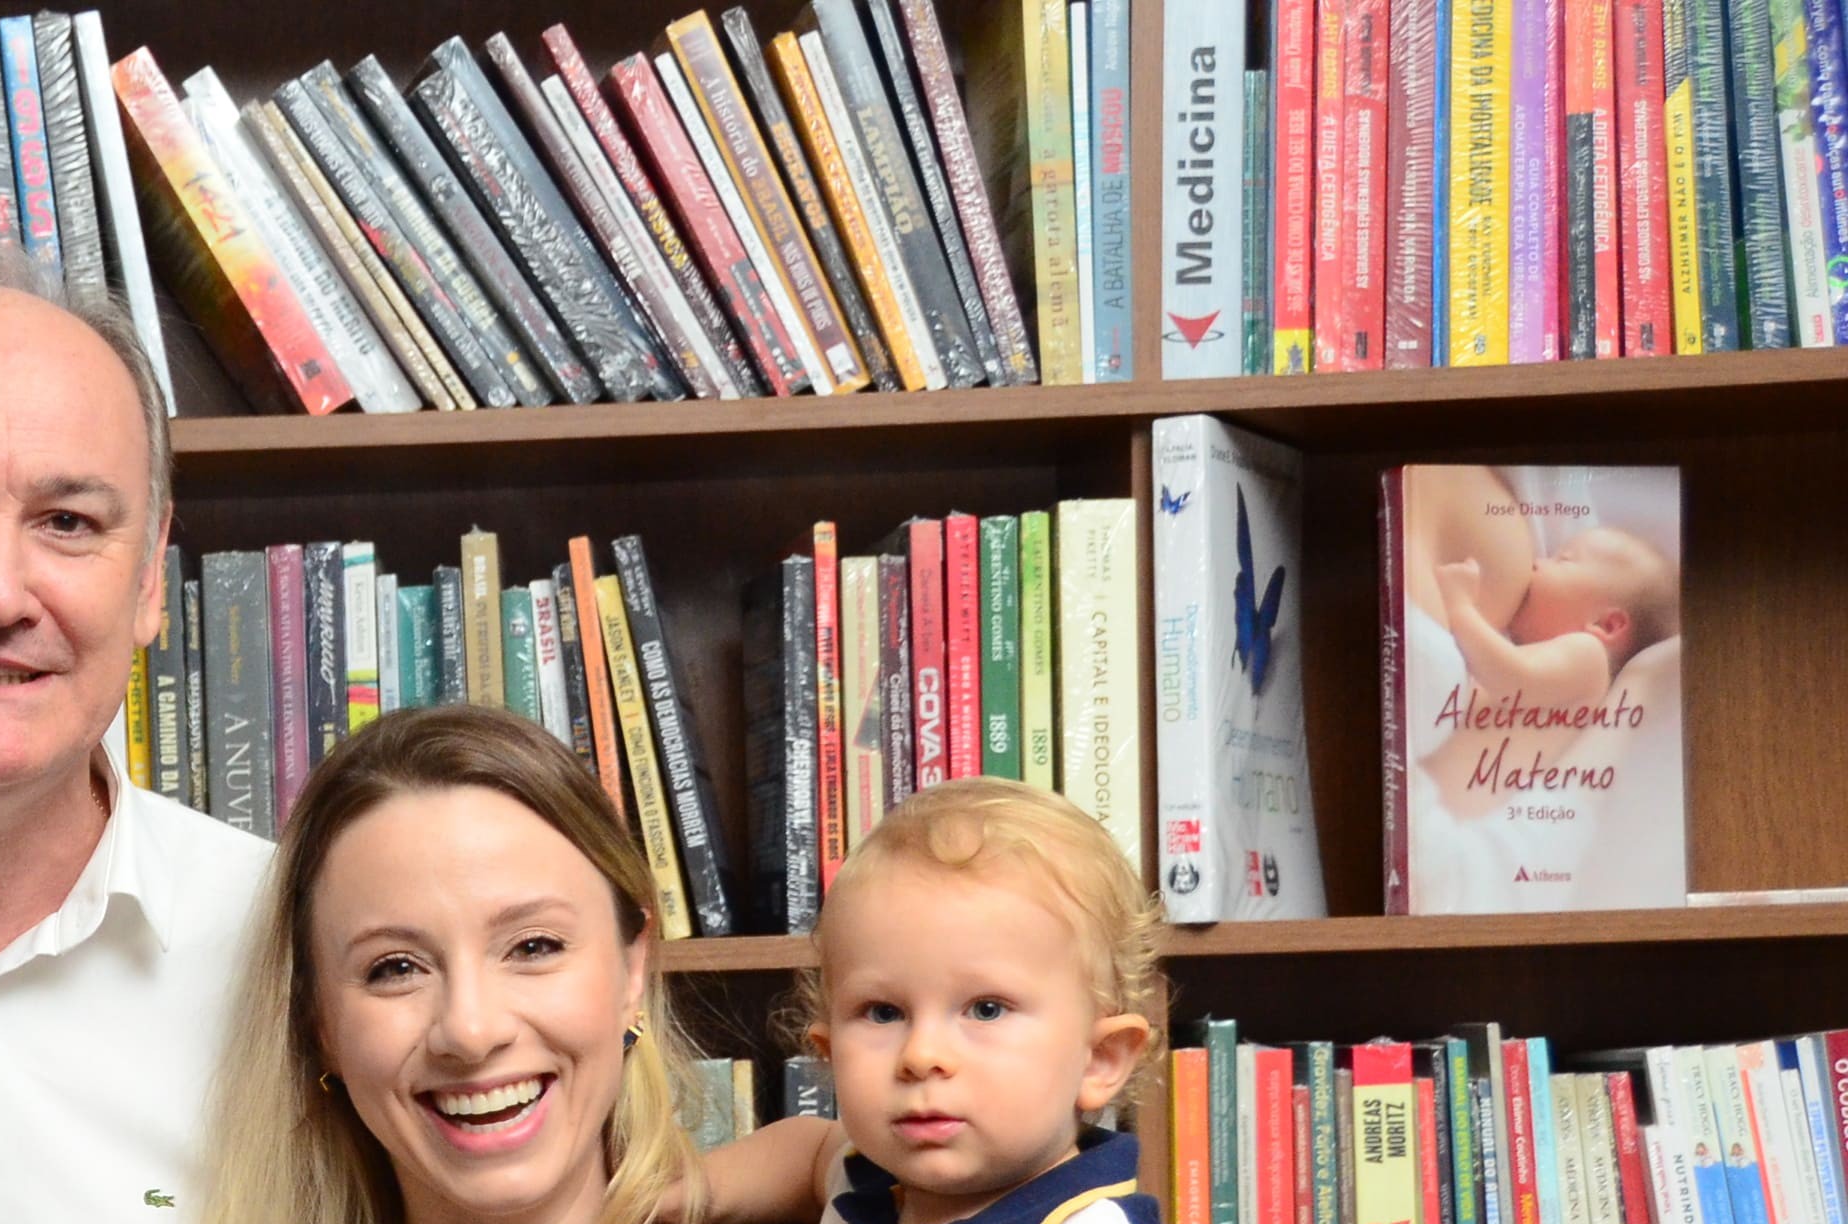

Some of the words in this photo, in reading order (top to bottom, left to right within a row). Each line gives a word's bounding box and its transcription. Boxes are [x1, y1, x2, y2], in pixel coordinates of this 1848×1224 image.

[1101, 88, 1123, 174] MOSCOU
[1322, 116, 1337, 127] A
[1174, 45, 1217, 286] Medicina
[1321, 130, 1337, 169] DIETA
[1513, 104, 1527, 200] AROMATERAPIA
[1103, 179, 1123, 201] DE
[1321, 172, 1340, 261] CETOGÊNICA
[1513, 216, 1526, 247] CURA
[1104, 208, 1124, 291] BATALHA
[1107, 296, 1124, 309] A
[1520, 502, 1550, 517] Dias
[1554, 502, 1590, 519] Rego
[536, 597, 556, 666] BRASIL
[990, 614, 1004, 661] GOMES
[1091, 611, 1108, 689] CAPITAL
[157, 676, 175, 687] A
[639, 640, 668, 680] COMO
[1161, 617, 1181, 723] Humano
[651, 682, 670, 699] AS
[1094, 696, 1108, 706] E
[1435, 689, 1645, 731] Aleitamento
[158, 692, 178, 764] CAMINHO
[654, 700, 689, 789] DEMOCRACIAS
[988, 713, 1007, 753] 1889
[1031, 728, 1048, 766] 1889
[161, 770, 179, 792] DA
[1094, 715, 1111, 822] IDEOLOGIA
[1468, 737, 1615, 794] Materno
[674, 792, 705, 849] MORREM
[1527, 805, 1575, 824] Edição
[1362, 1099, 1384, 1164] ANDREAS
[1385, 1102, 1406, 1158] MORITZ
